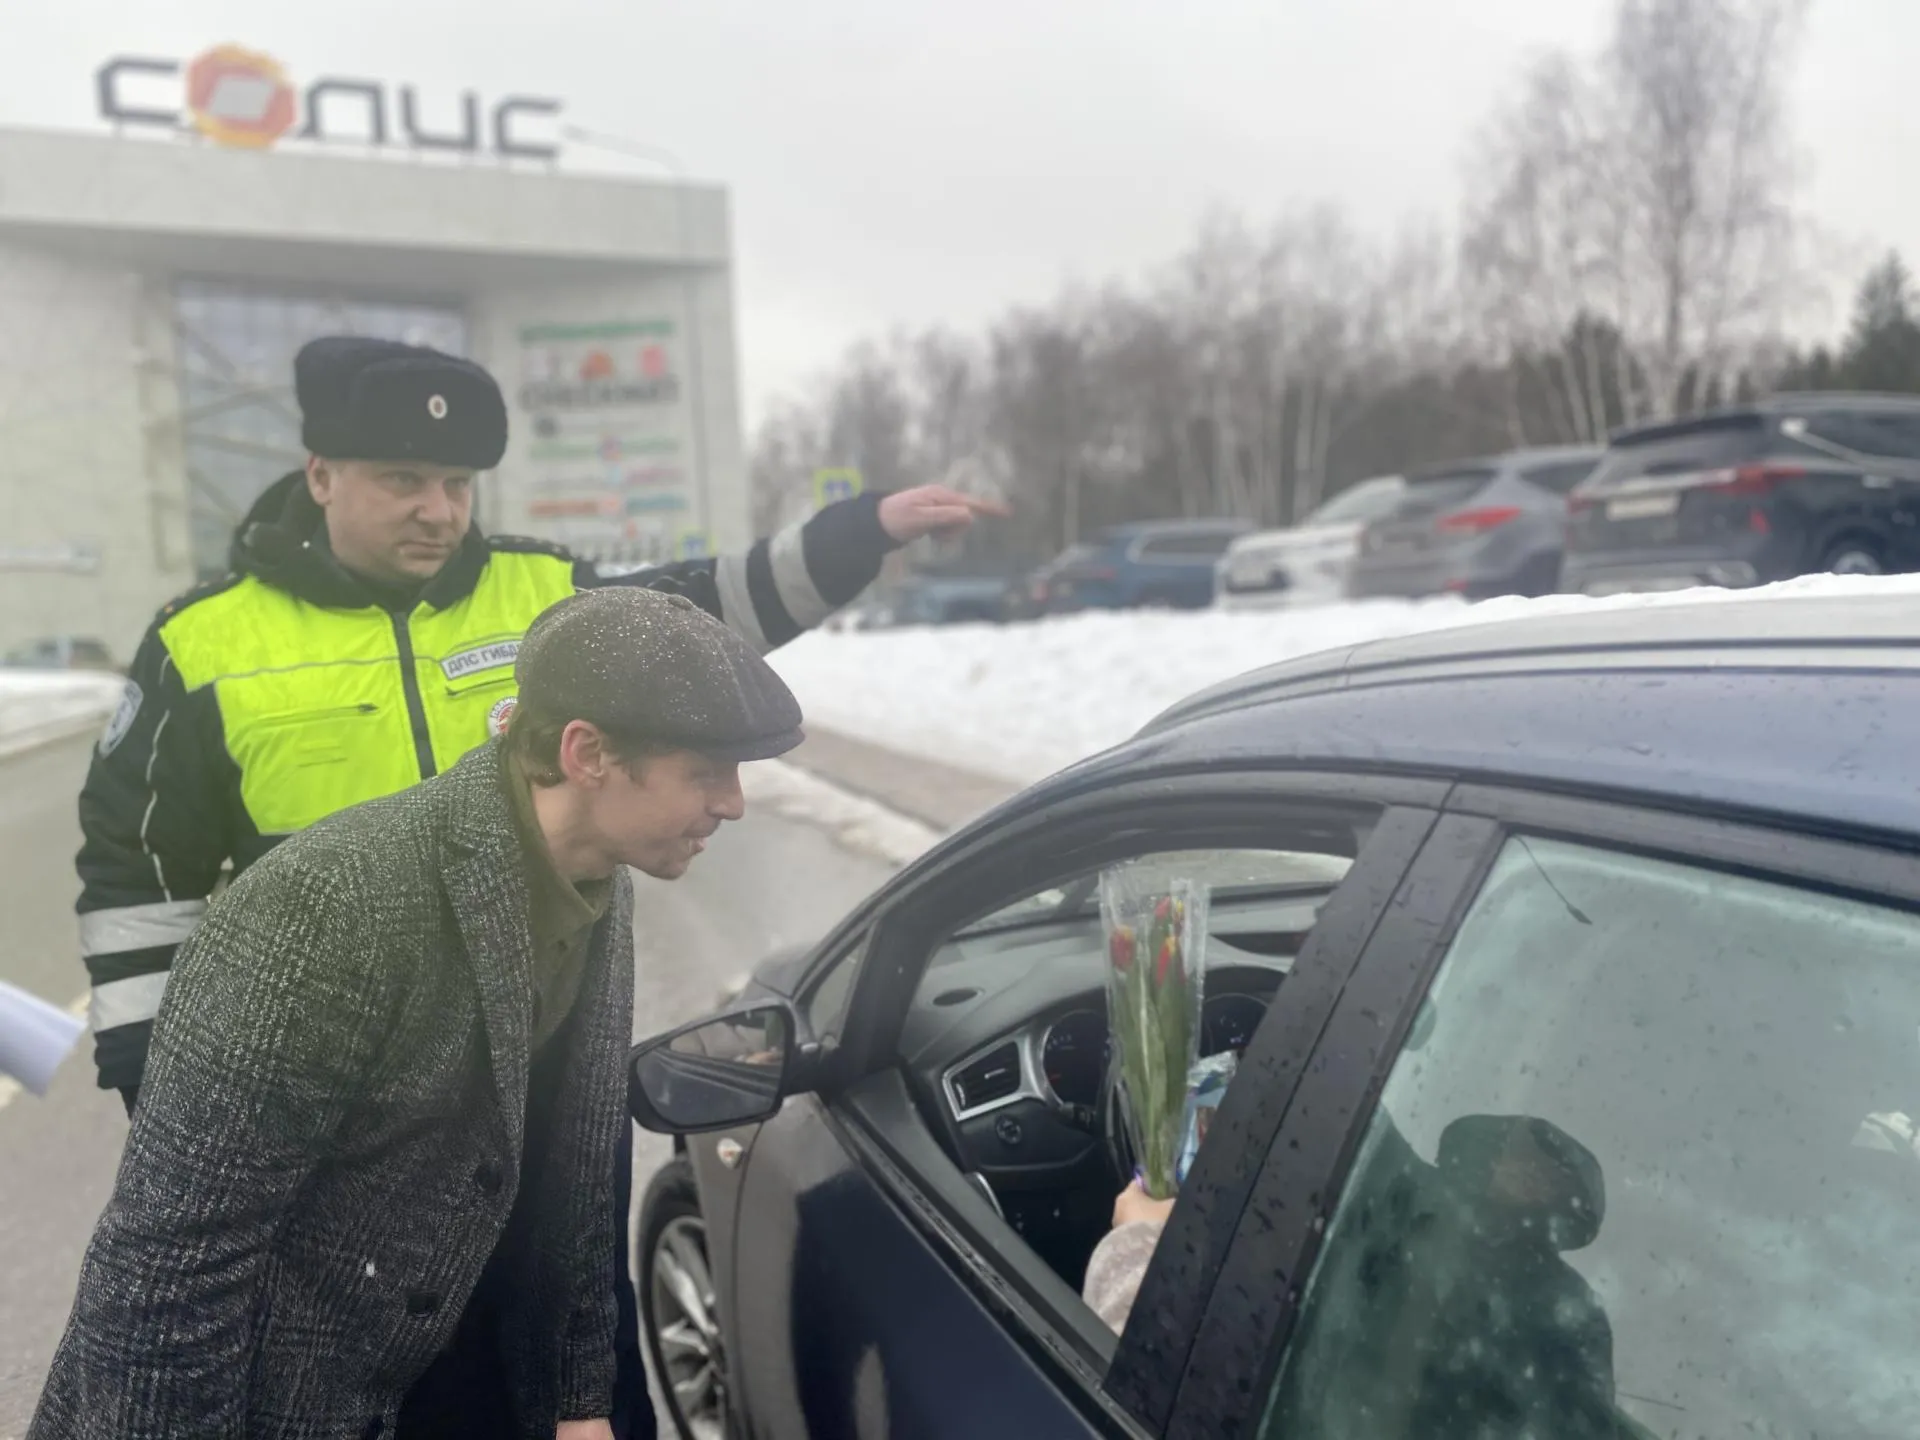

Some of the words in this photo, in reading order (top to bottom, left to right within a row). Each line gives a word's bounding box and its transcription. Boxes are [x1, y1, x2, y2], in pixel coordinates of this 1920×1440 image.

[95, 43, 562, 158] СОЛИС
[448, 654, 480, 674] ДПС
[481, 643, 519, 662] ГИБД
